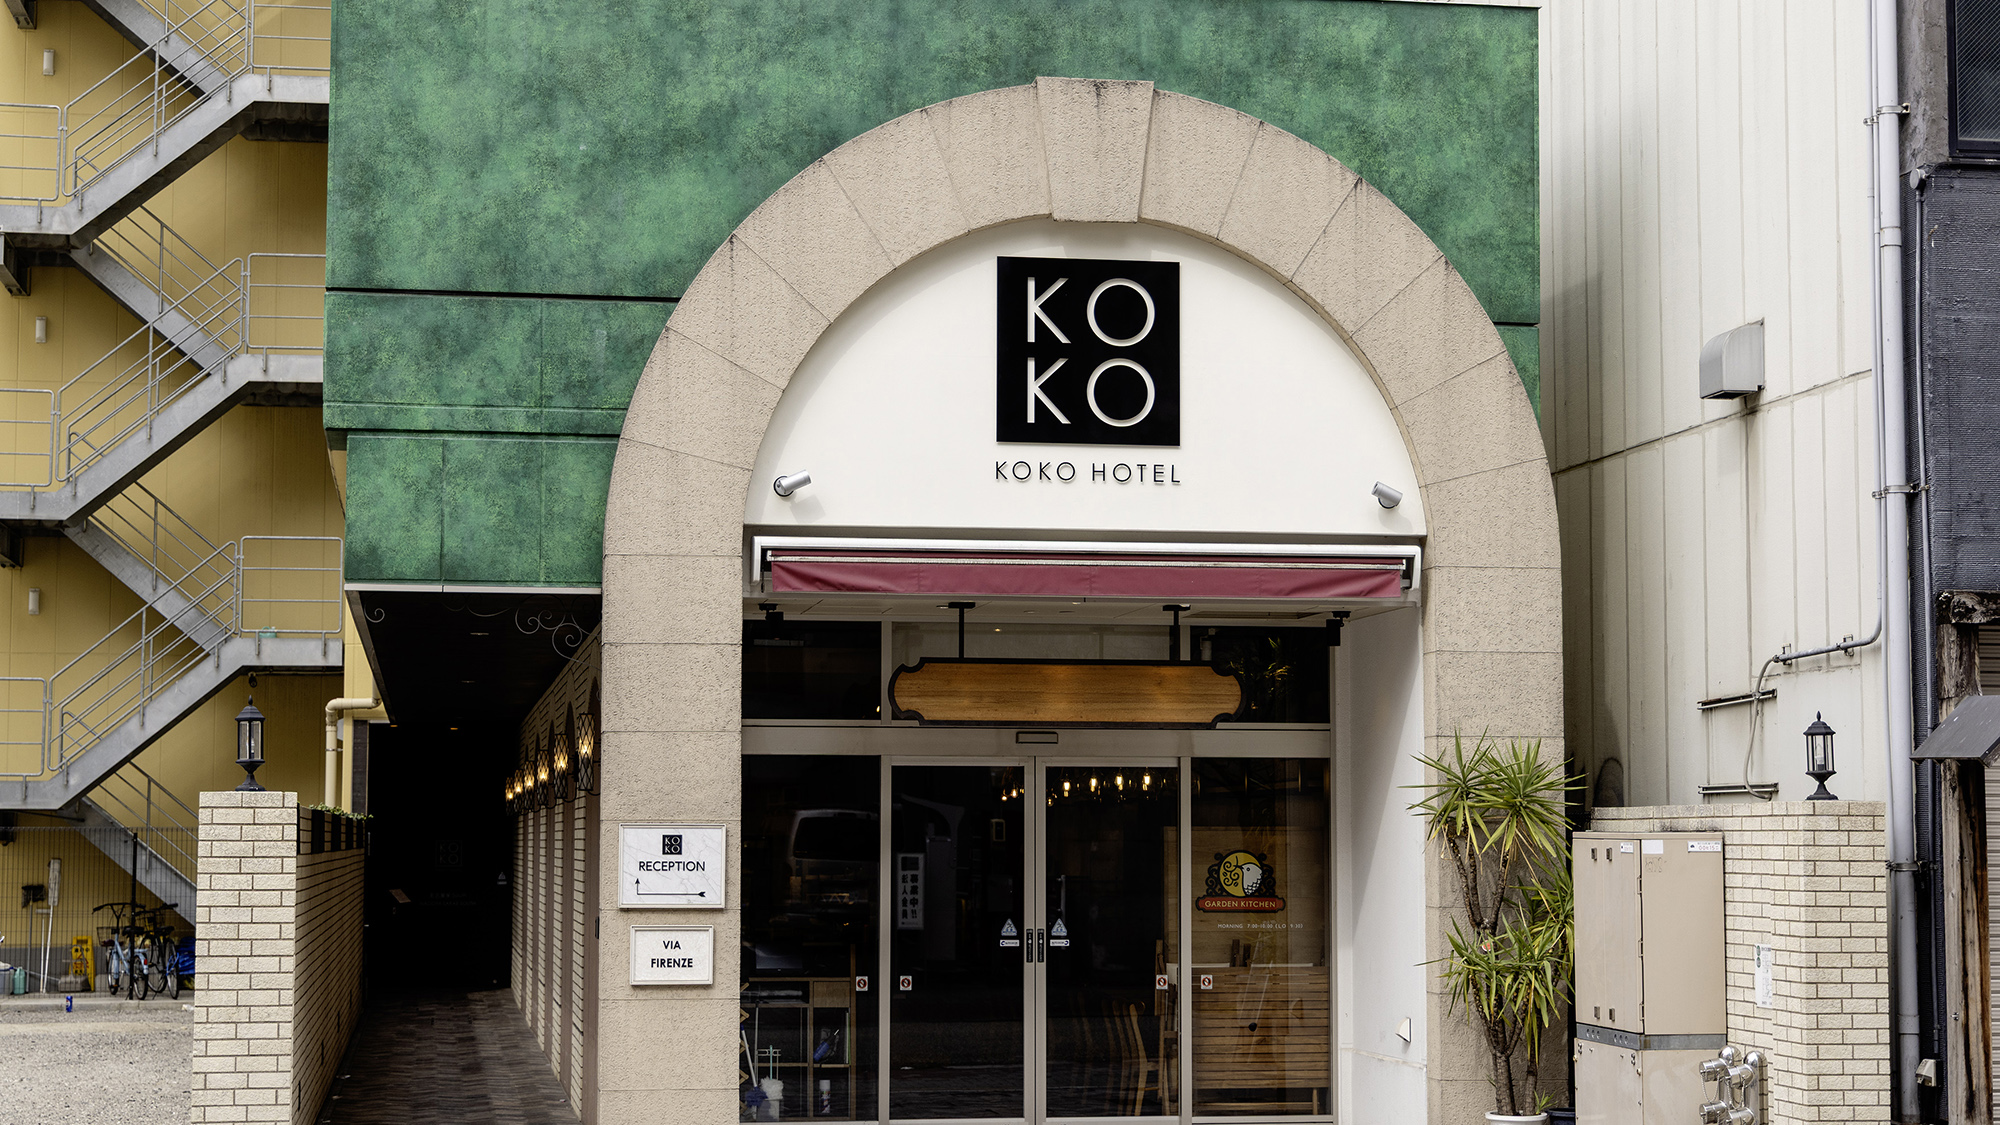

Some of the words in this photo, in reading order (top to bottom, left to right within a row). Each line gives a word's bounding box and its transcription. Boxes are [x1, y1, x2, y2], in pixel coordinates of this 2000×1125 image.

[1027, 276, 1156, 347] KO
[1027, 357, 1156, 428] KO
[995, 461, 1076, 481] KOKO
[1092, 463, 1181, 484] HOTEL
[664, 836, 681, 845] KO
[664, 845, 681, 854] KO
[638, 860, 706, 872] RECEPTION
[1204, 900, 1238, 908] GARDEN
[1240, 900, 1276, 908] KITCHEN
[662, 940, 682, 950] VIA
[650, 958, 694, 968] FIRENZE
